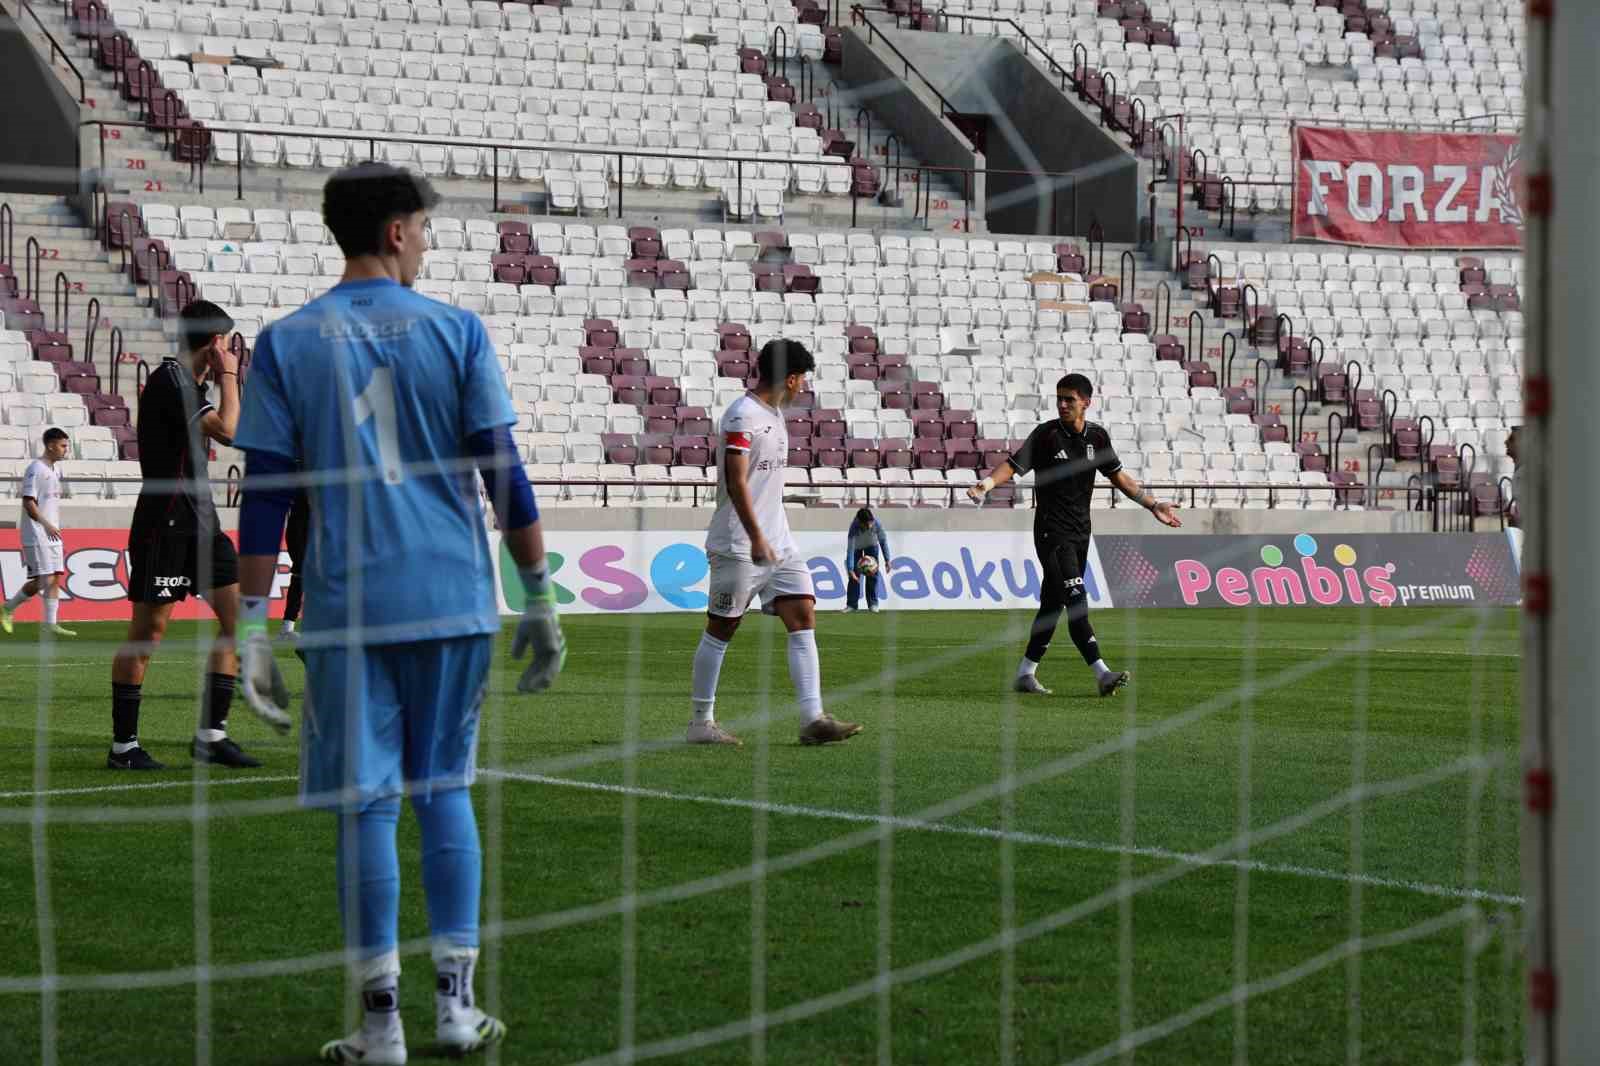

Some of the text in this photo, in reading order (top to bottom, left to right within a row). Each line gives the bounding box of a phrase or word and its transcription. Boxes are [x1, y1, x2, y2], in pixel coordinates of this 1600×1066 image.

[127, 159, 145, 170] 20
[143, 180, 163, 192] 21
[1302, 159, 1508, 223] FORZA
[1172, 316, 1188, 329] 23
[353, 366, 404, 486] 1
[1397, 583, 1476, 607] premium
